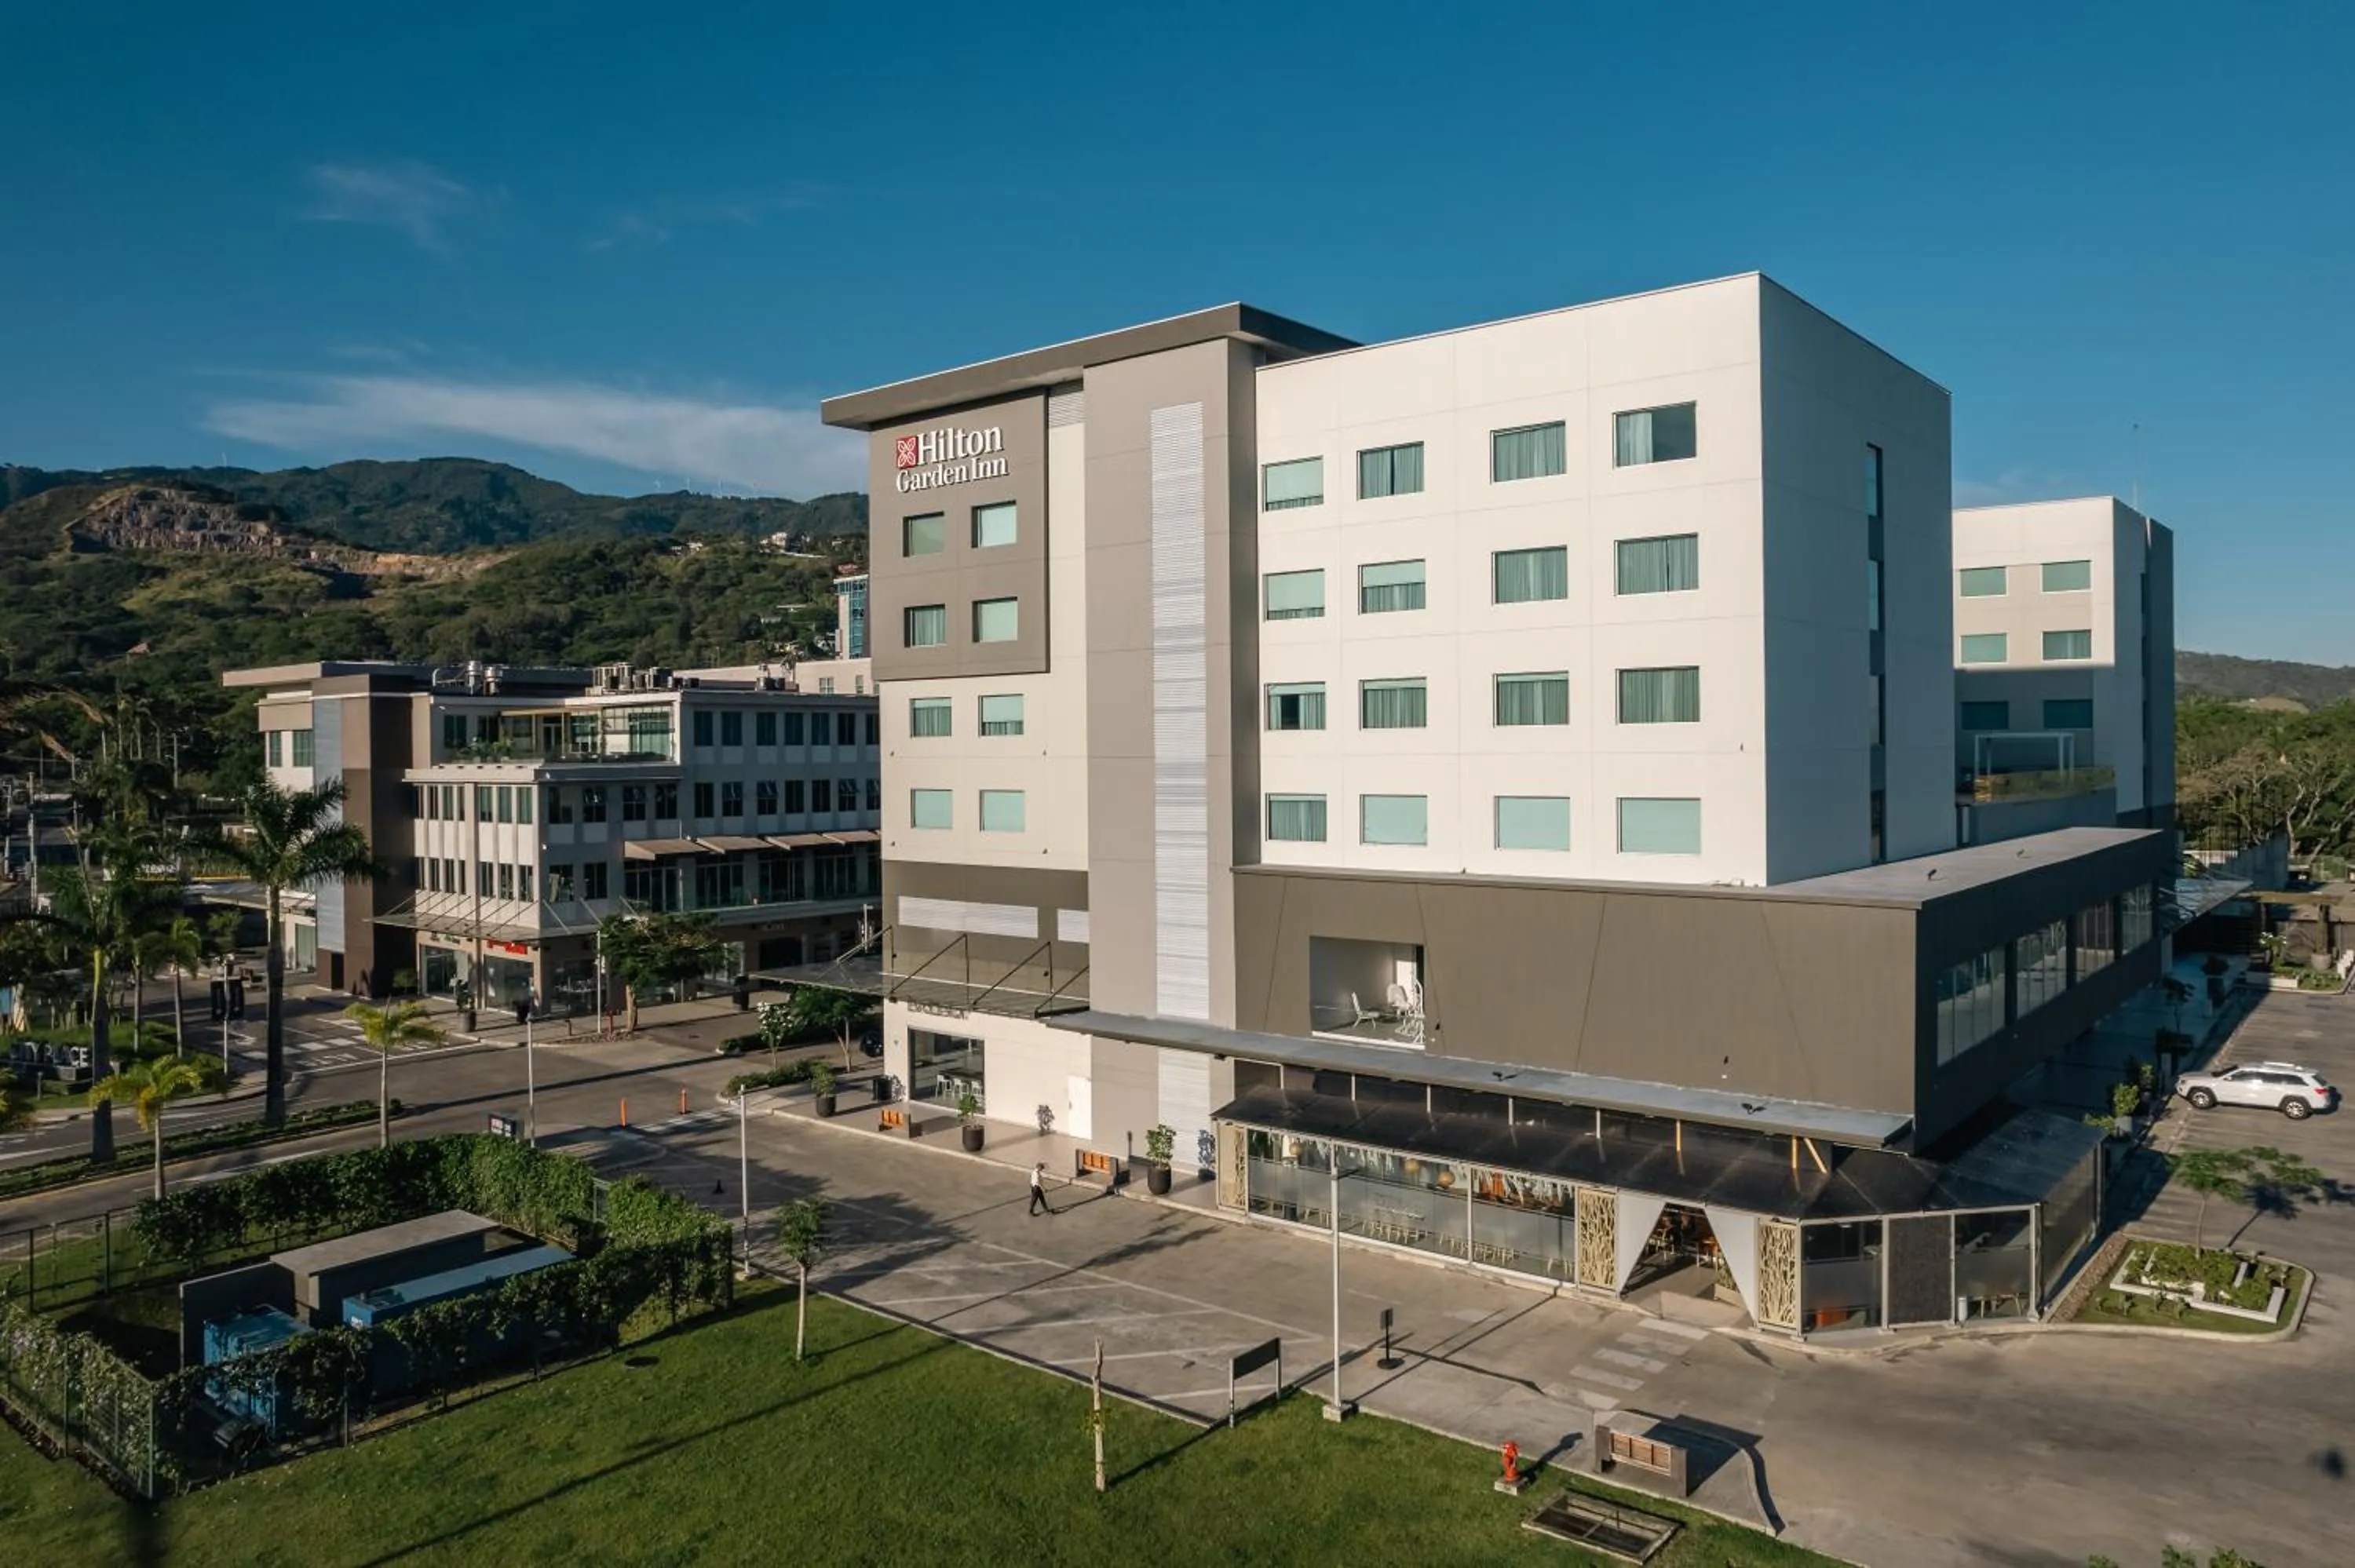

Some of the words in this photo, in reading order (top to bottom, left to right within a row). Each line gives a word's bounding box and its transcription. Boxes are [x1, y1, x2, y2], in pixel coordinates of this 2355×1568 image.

[918, 427, 1002, 465] Hilton
[896, 464, 968, 492] Garden
[970, 458, 1008, 480] Inn
